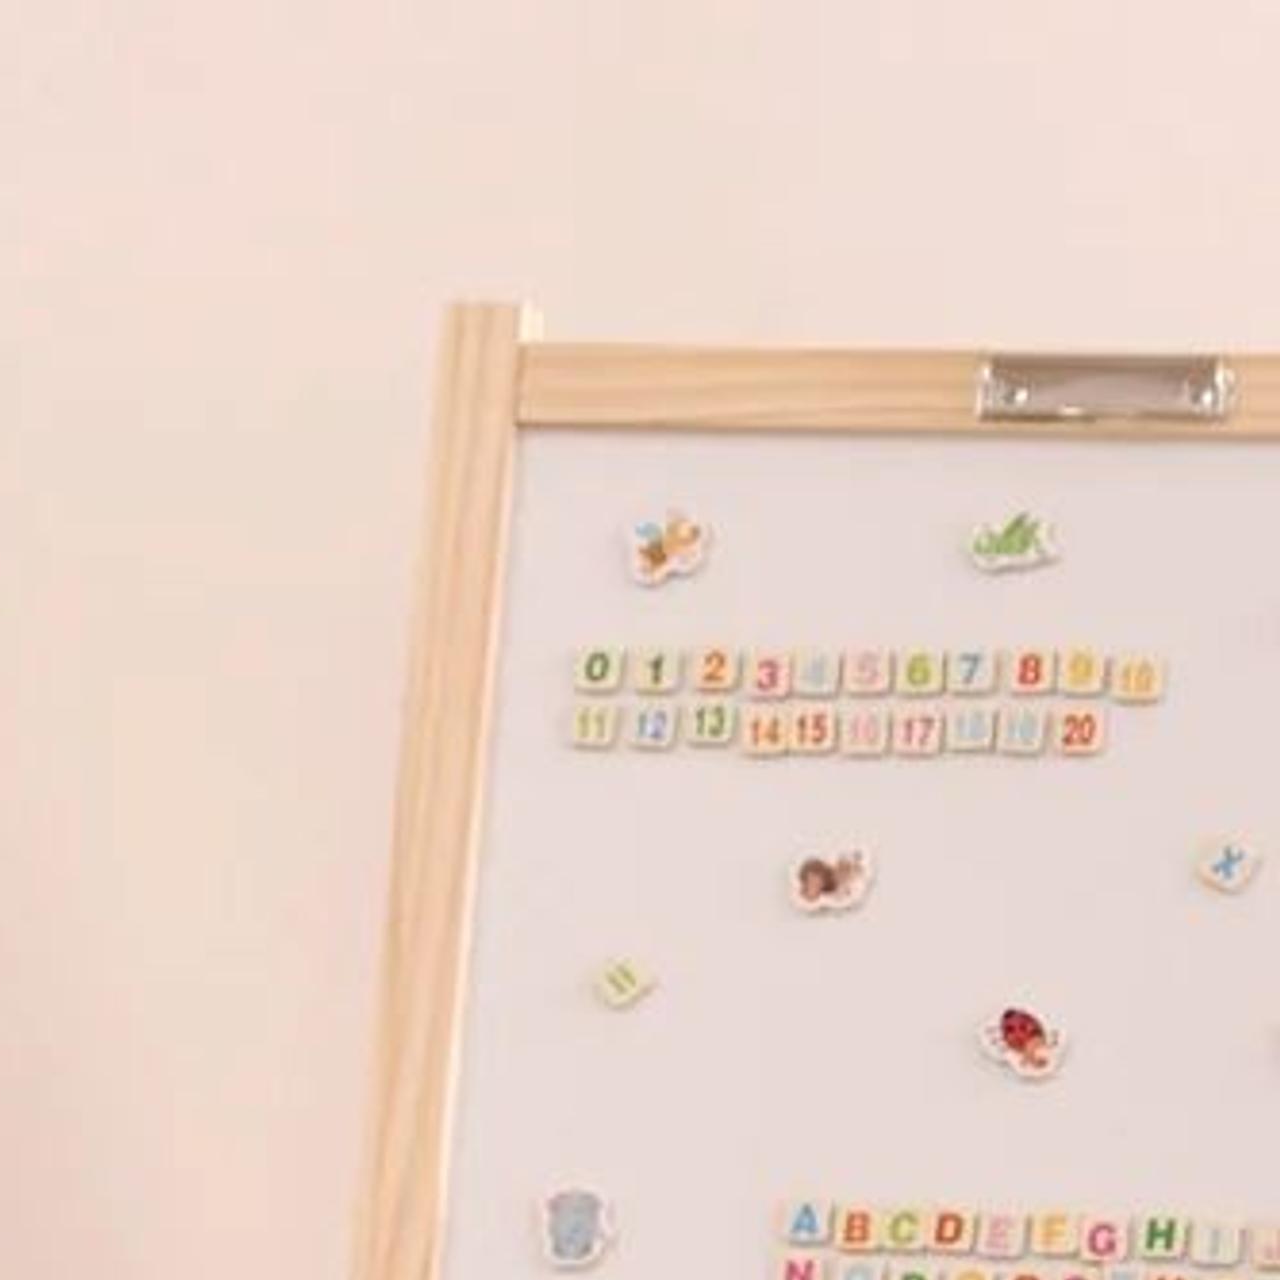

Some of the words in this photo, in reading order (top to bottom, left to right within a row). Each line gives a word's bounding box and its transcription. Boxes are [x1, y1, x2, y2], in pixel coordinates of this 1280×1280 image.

[585, 652, 610, 682] 0
[649, 654, 664, 685] 1
[703, 651, 727, 682] 2
[756, 659, 778, 691] 3
[857, 652, 879, 684] 5
[906, 653, 931, 686] 6
[960, 652, 982, 685] 7
[1018, 653, 1042, 685] 8
[1068, 652, 1093, 685] 9
[1121, 658, 1156, 692] 10
[577, 709, 607, 738] 11
[638, 709, 667, 740] 12
[695, 705, 726, 737] 13
[751, 716, 781, 745] 14
[796, 713, 829, 743] 15
[903, 716, 936, 746] 17
[1061, 713, 1097, 746] 20
[792, 1203, 818, 1233] A
[843, 1212, 870, 1242] B
[891, 1212, 918, 1243] C
[935, 1213, 964, 1244] D
[986, 1217, 1011, 1248] E
[1043, 1216, 1067, 1246] F
[1088, 1223, 1117, 1255] G
[1145, 1219, 1175, 1250] H
